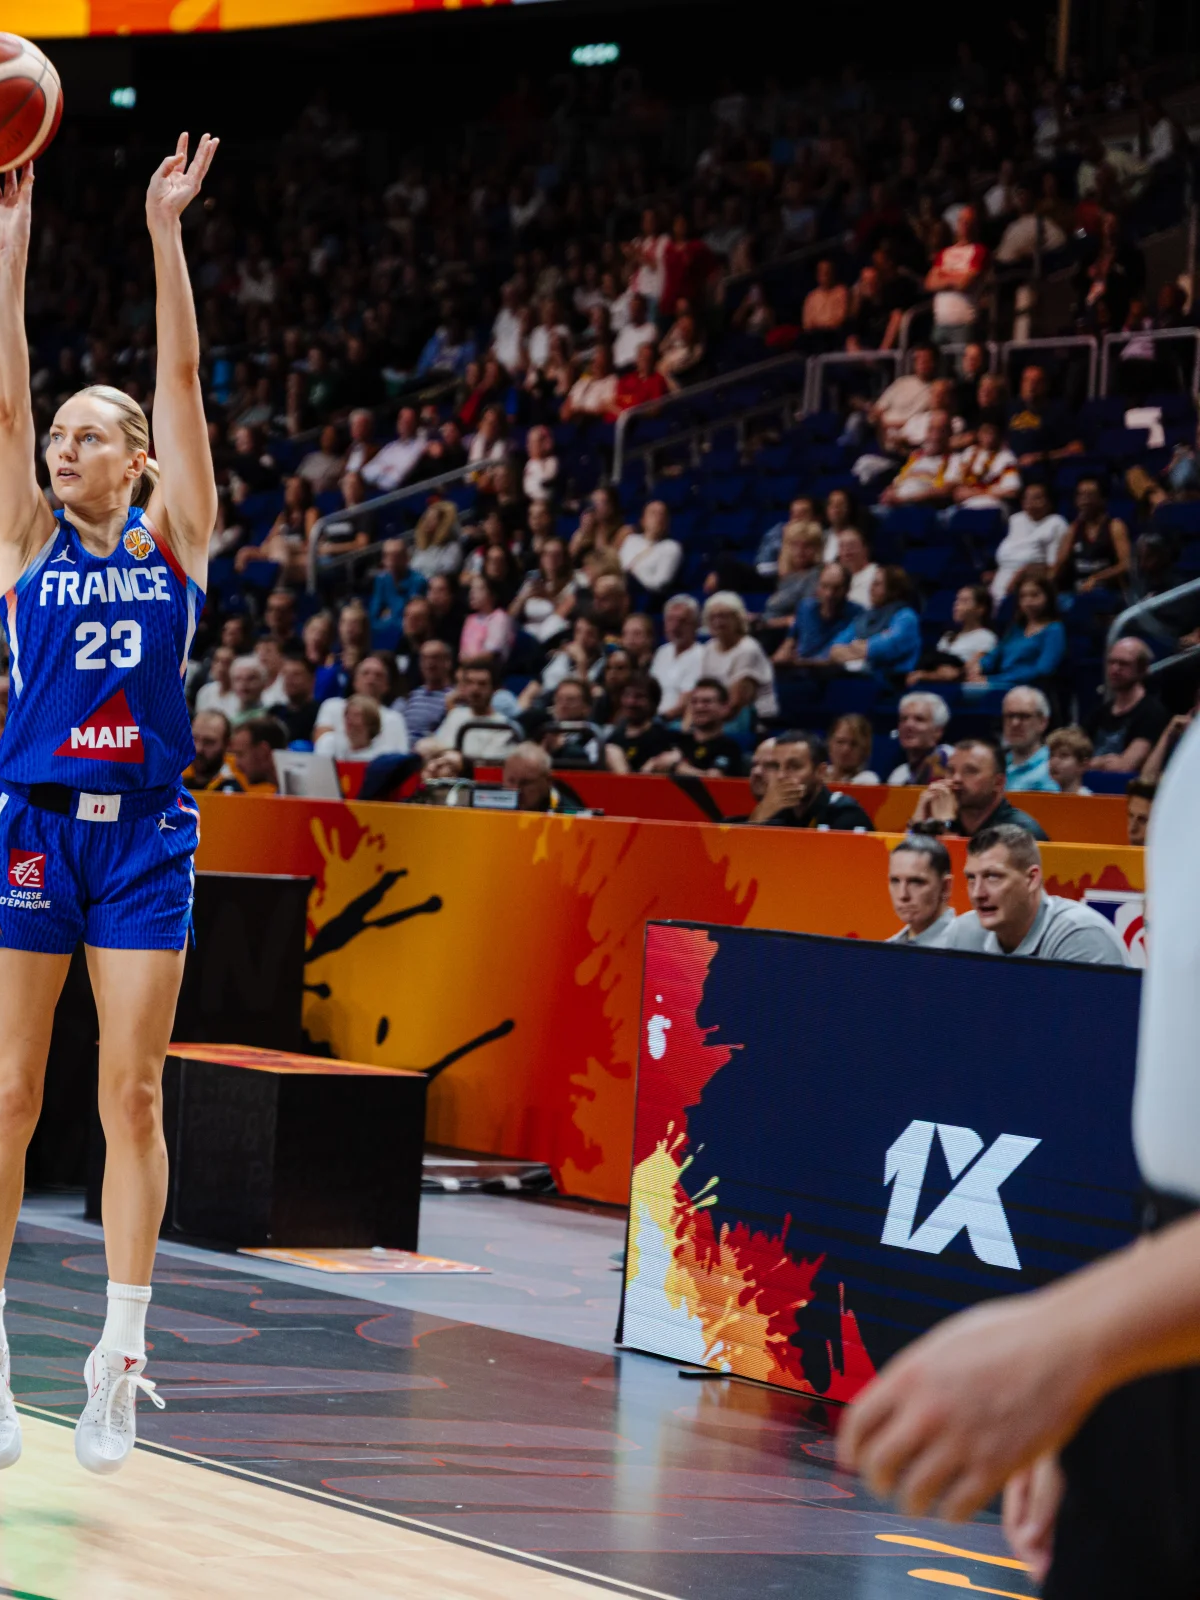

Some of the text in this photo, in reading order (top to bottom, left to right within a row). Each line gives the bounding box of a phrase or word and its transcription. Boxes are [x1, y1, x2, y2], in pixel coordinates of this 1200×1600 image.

[39, 566, 171, 607] FRANCE
[75, 620, 142, 670] 23
[70, 725, 140, 749] MAIF
[0, 895, 52, 909] D'EPARGNE
[10, 889, 43, 900] CAISSE
[880, 1119, 1042, 1271] 1X
